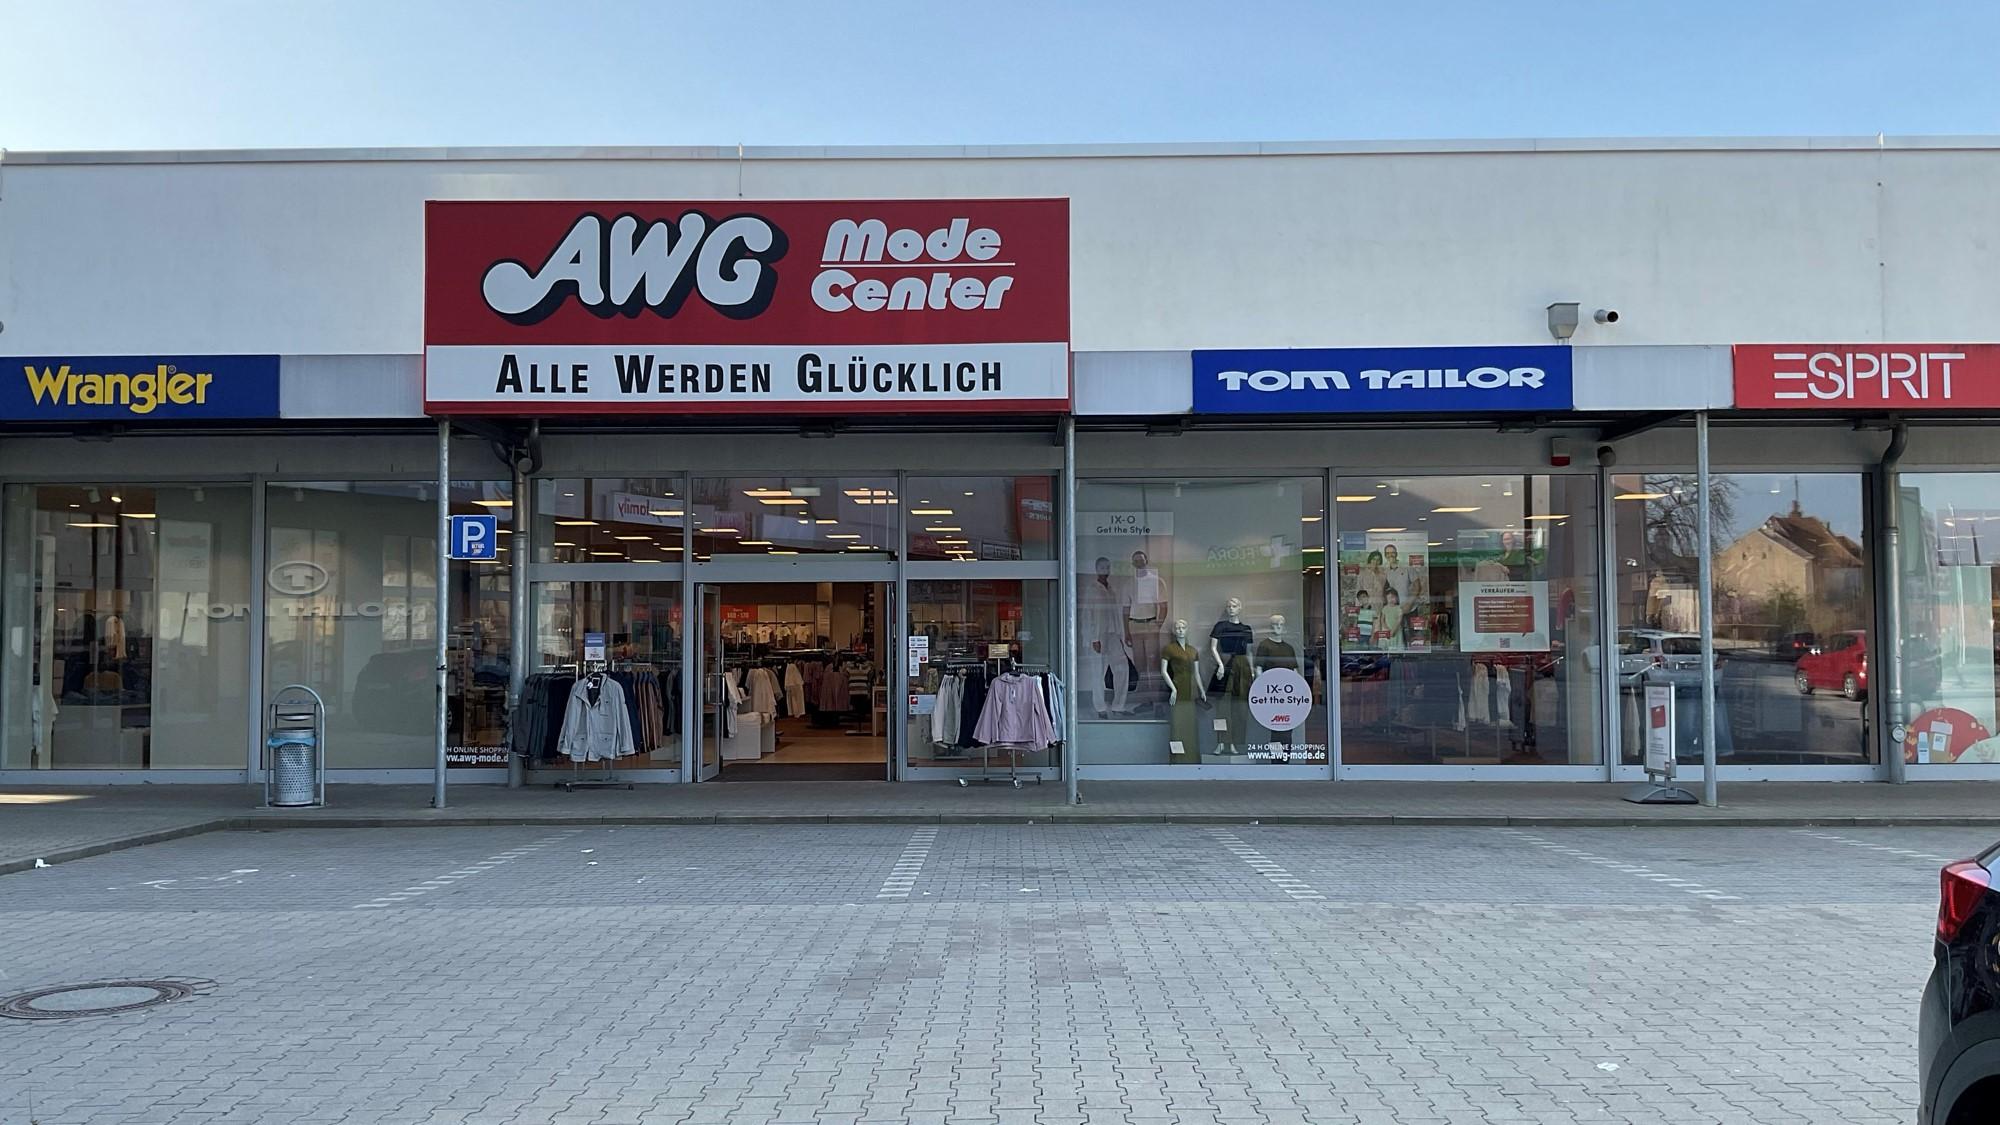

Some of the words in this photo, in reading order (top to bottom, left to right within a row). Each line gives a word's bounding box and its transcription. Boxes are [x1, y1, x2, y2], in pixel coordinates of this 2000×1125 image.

[821, 217, 1002, 262] Mode
[481, 210, 782, 324] AWG
[811, 269, 1014, 313] Center
[24, 364, 213, 414] Wrangler
[495, 354, 589, 394] ALLE
[613, 354, 771, 394] WERDEN
[797, 353, 1001, 393] GLÜCKLICH
[1217, 369, 1351, 392] TOM
[1360, 366, 1546, 390] TAILOR
[1773, 352, 1966, 399] ESPRIT
[1096, 526, 1112, 534] Get
[1114, 526, 1128, 534] the
[1129, 526, 1151, 535] Style
[1111, 515, 1136, 525] IX-O
[462, 521, 486, 553] P
[1250, 696, 1268, 704] Get
[1269, 695, 1285, 704] the
[1287, 695, 1310, 706] Style
[1266, 684, 1294, 694] IX-O
[1247, 750, 1326, 761] www.awg-mode.de
